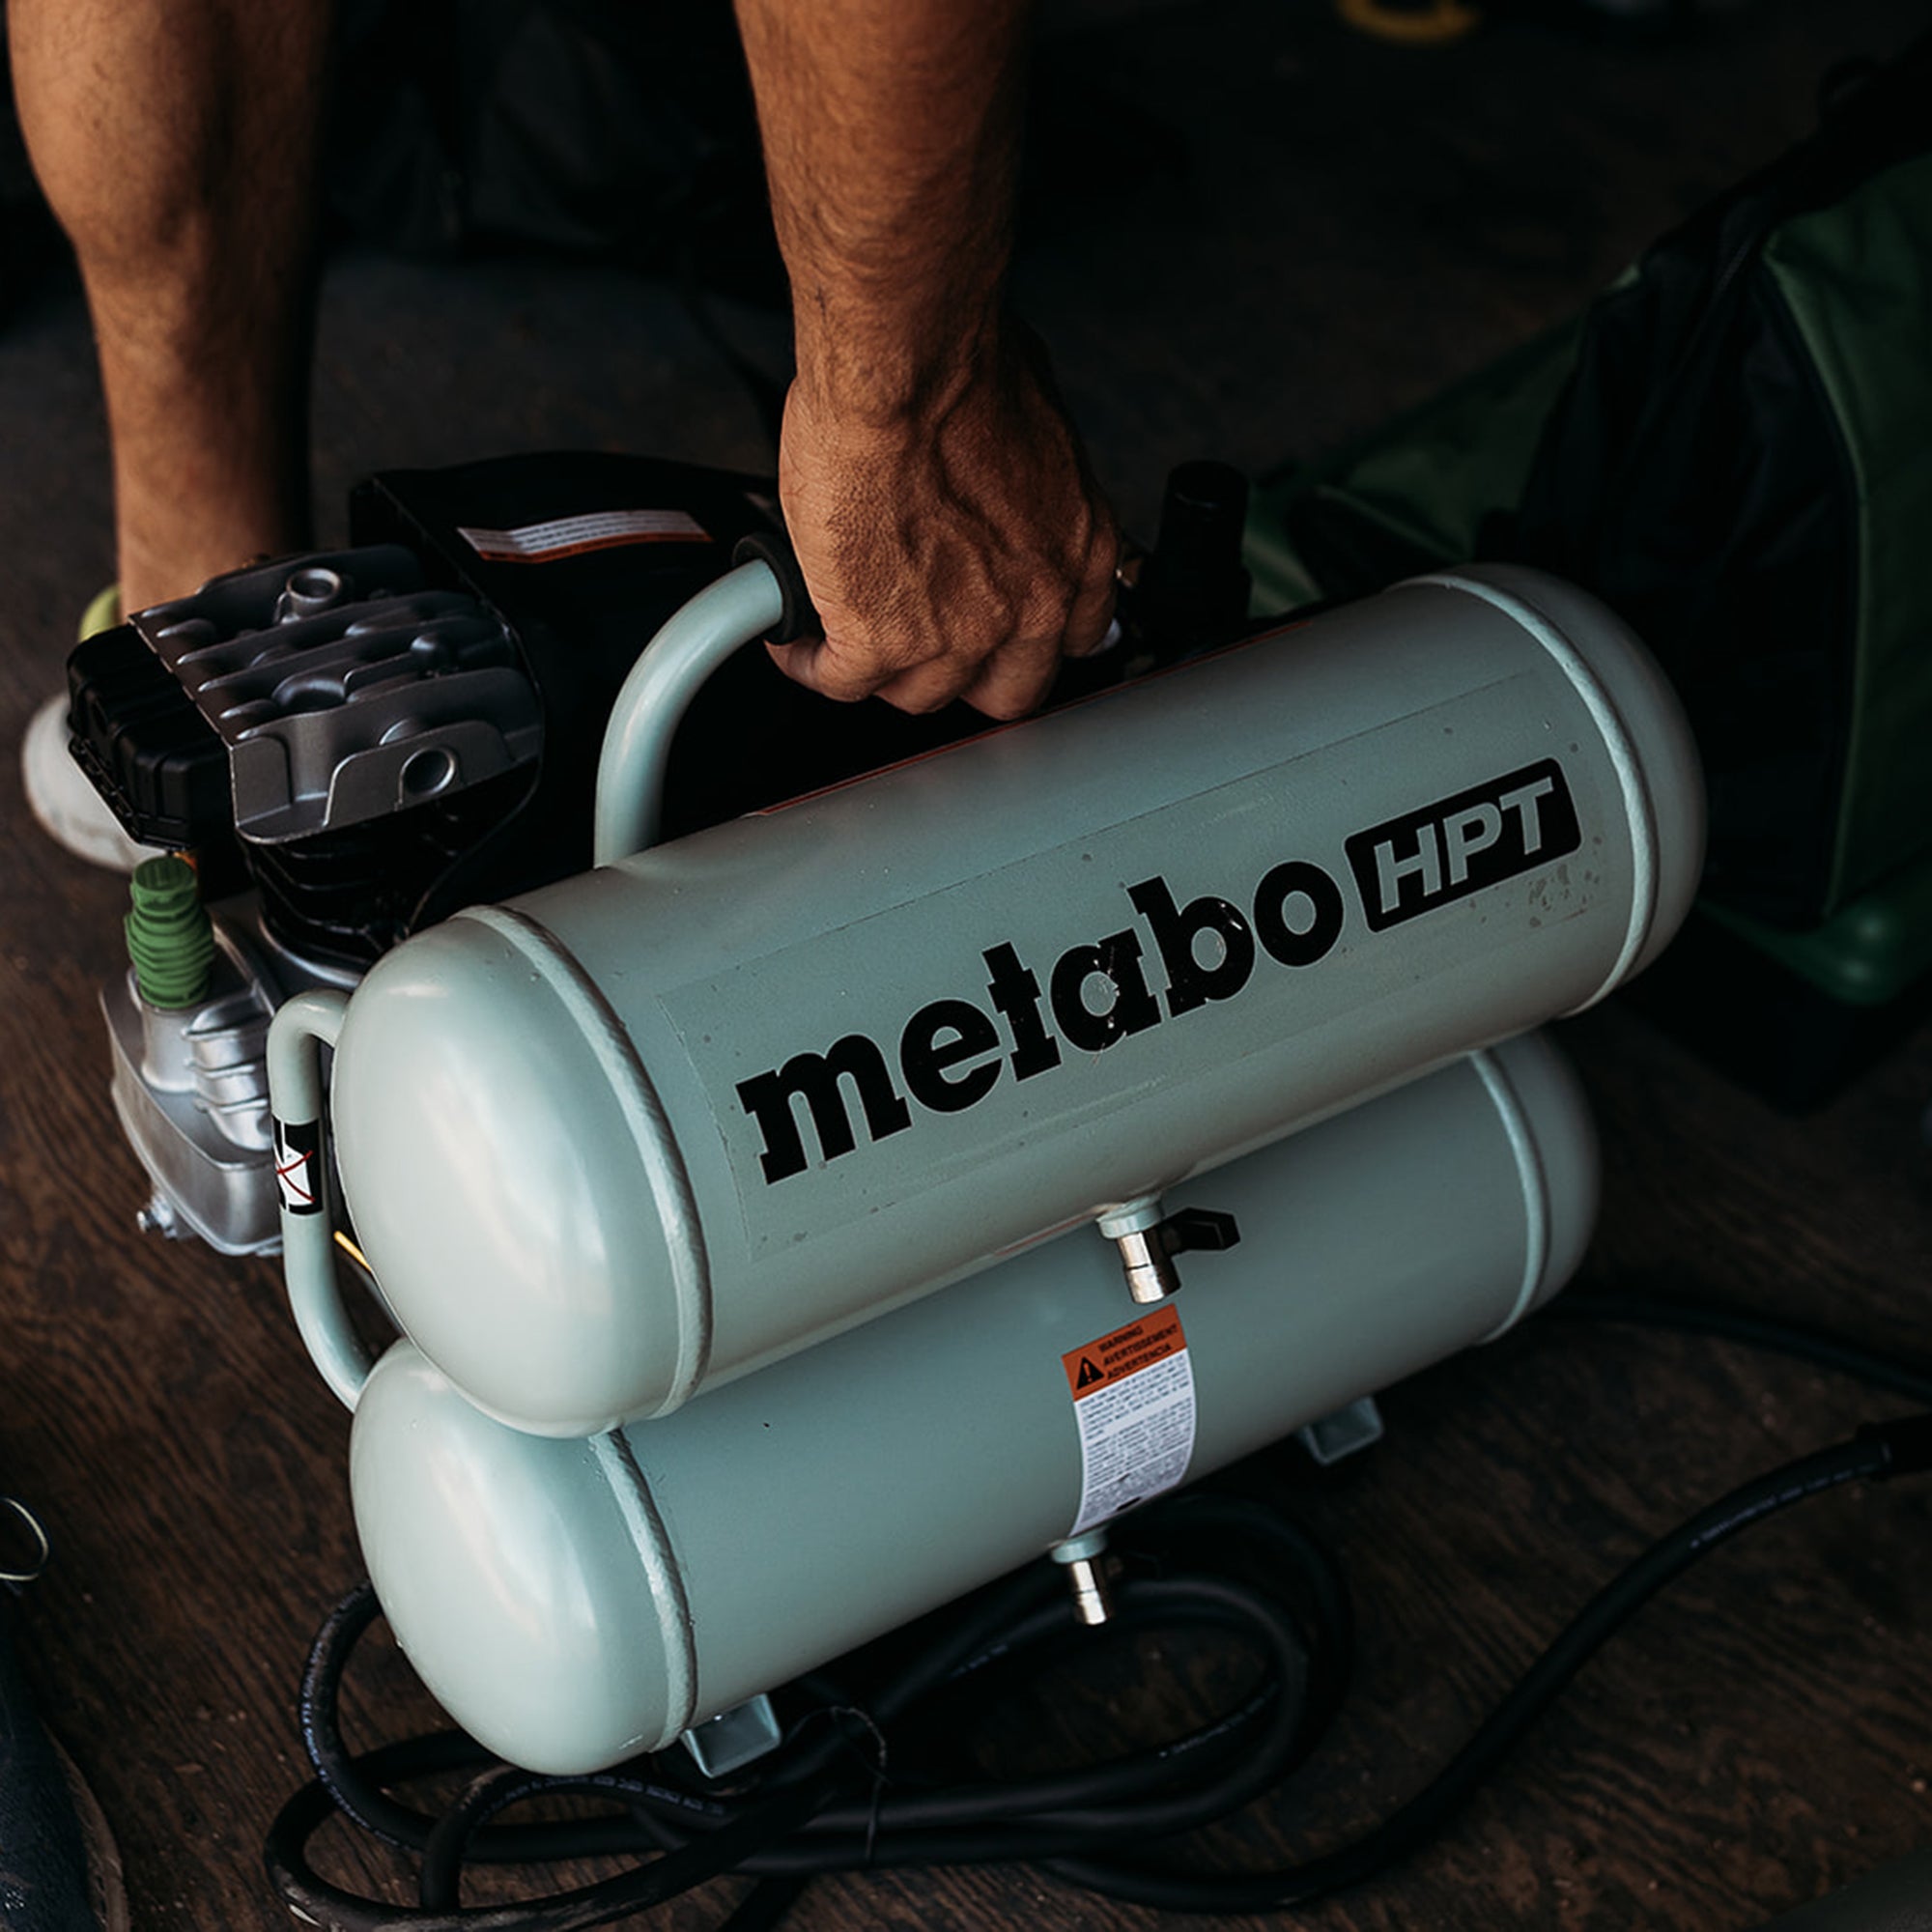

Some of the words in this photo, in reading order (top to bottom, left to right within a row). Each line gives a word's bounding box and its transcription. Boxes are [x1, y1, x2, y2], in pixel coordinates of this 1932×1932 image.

[734, 860, 1345, 1186] metabo
[1371, 776, 1554, 915] HPT
[1098, 1324, 1144, 1353] WARNING
